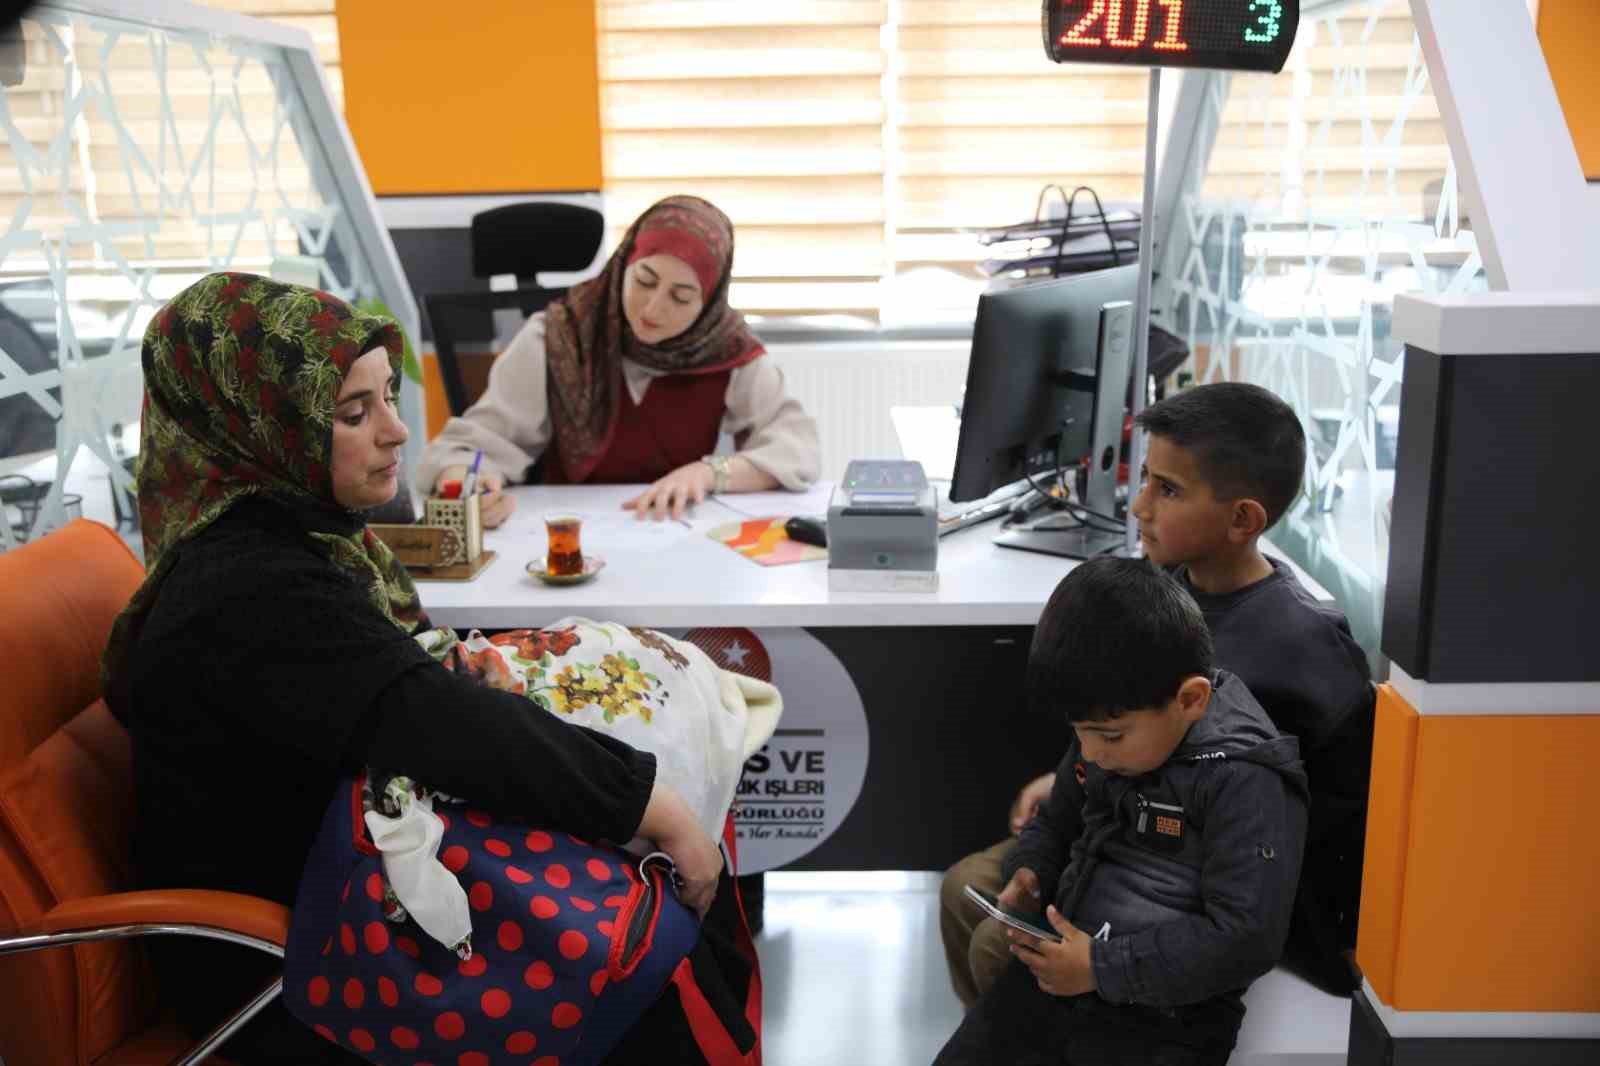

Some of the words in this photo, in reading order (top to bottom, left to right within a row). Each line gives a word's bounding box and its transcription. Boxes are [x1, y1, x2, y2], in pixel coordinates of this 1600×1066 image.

[1060, 0, 1188, 50] 201
[1244, 0, 1282, 42] 3
[779, 750, 825, 774] VE
